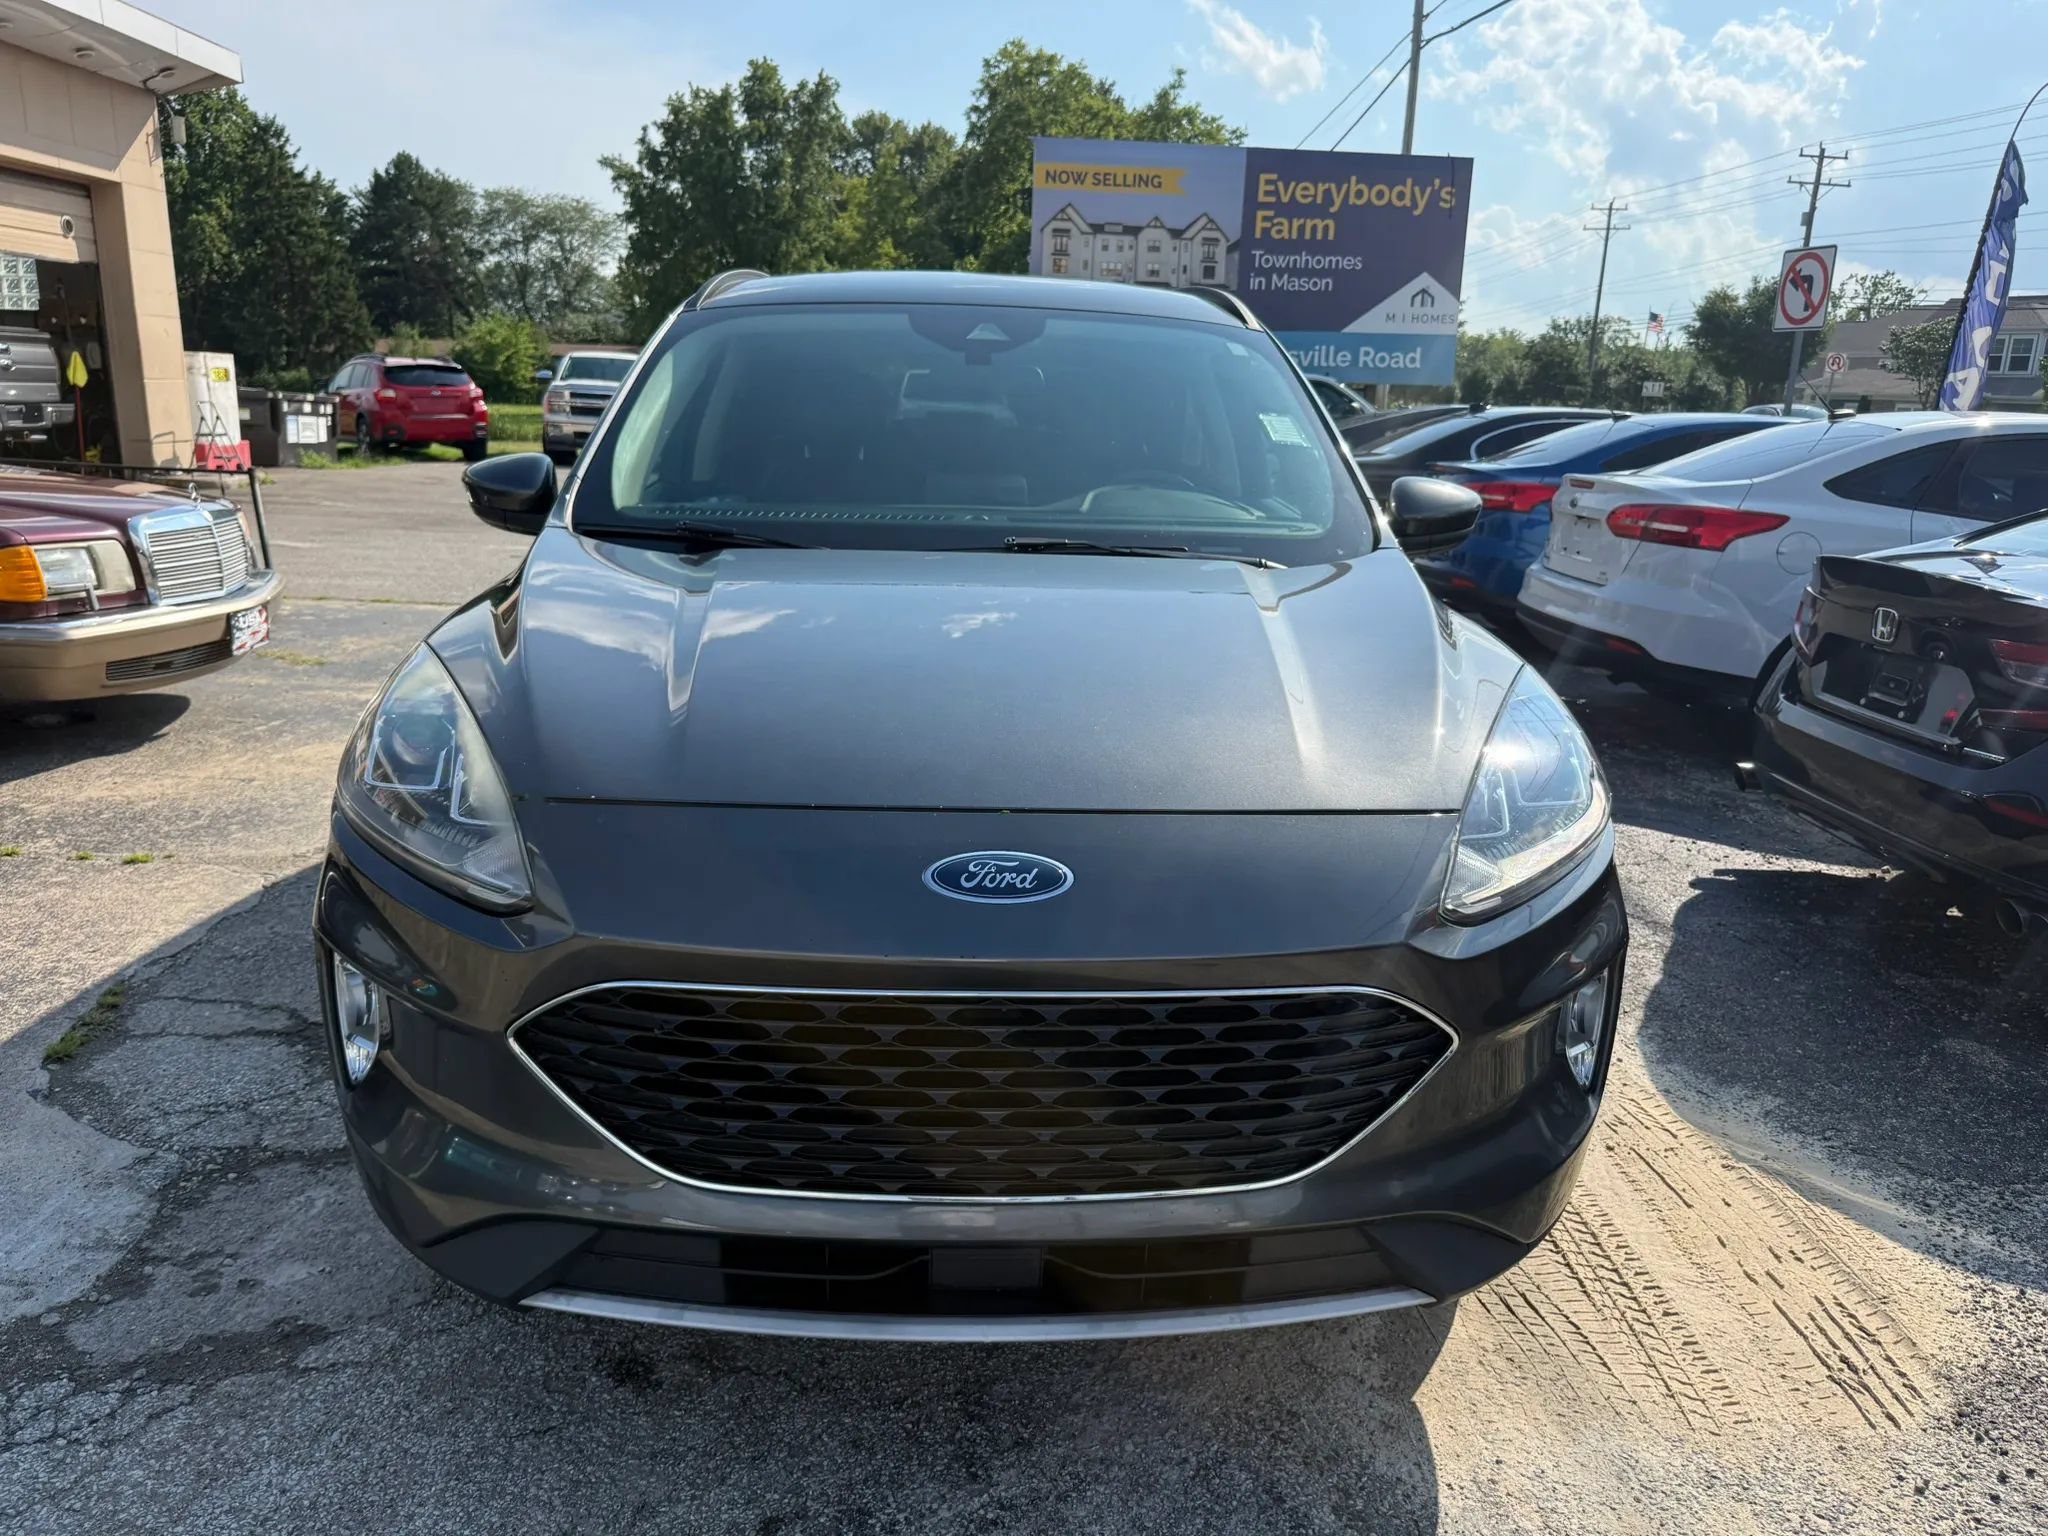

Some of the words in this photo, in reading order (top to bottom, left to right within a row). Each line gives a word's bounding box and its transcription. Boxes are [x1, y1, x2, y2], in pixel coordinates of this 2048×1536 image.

[1045, 169, 1087, 185] NOW
[1092, 172, 1163, 189] SELLING
[1254, 210, 1336, 240] Farm
[1251, 250, 1363, 270] Townhomes
[1249, 273, 1266, 291] in
[1271, 274, 1333, 291] Mason
[1411, 313, 1455, 324] HOMES
[1358, 346, 1422, 369] Road
[960, 859, 1038, 889] Ford
